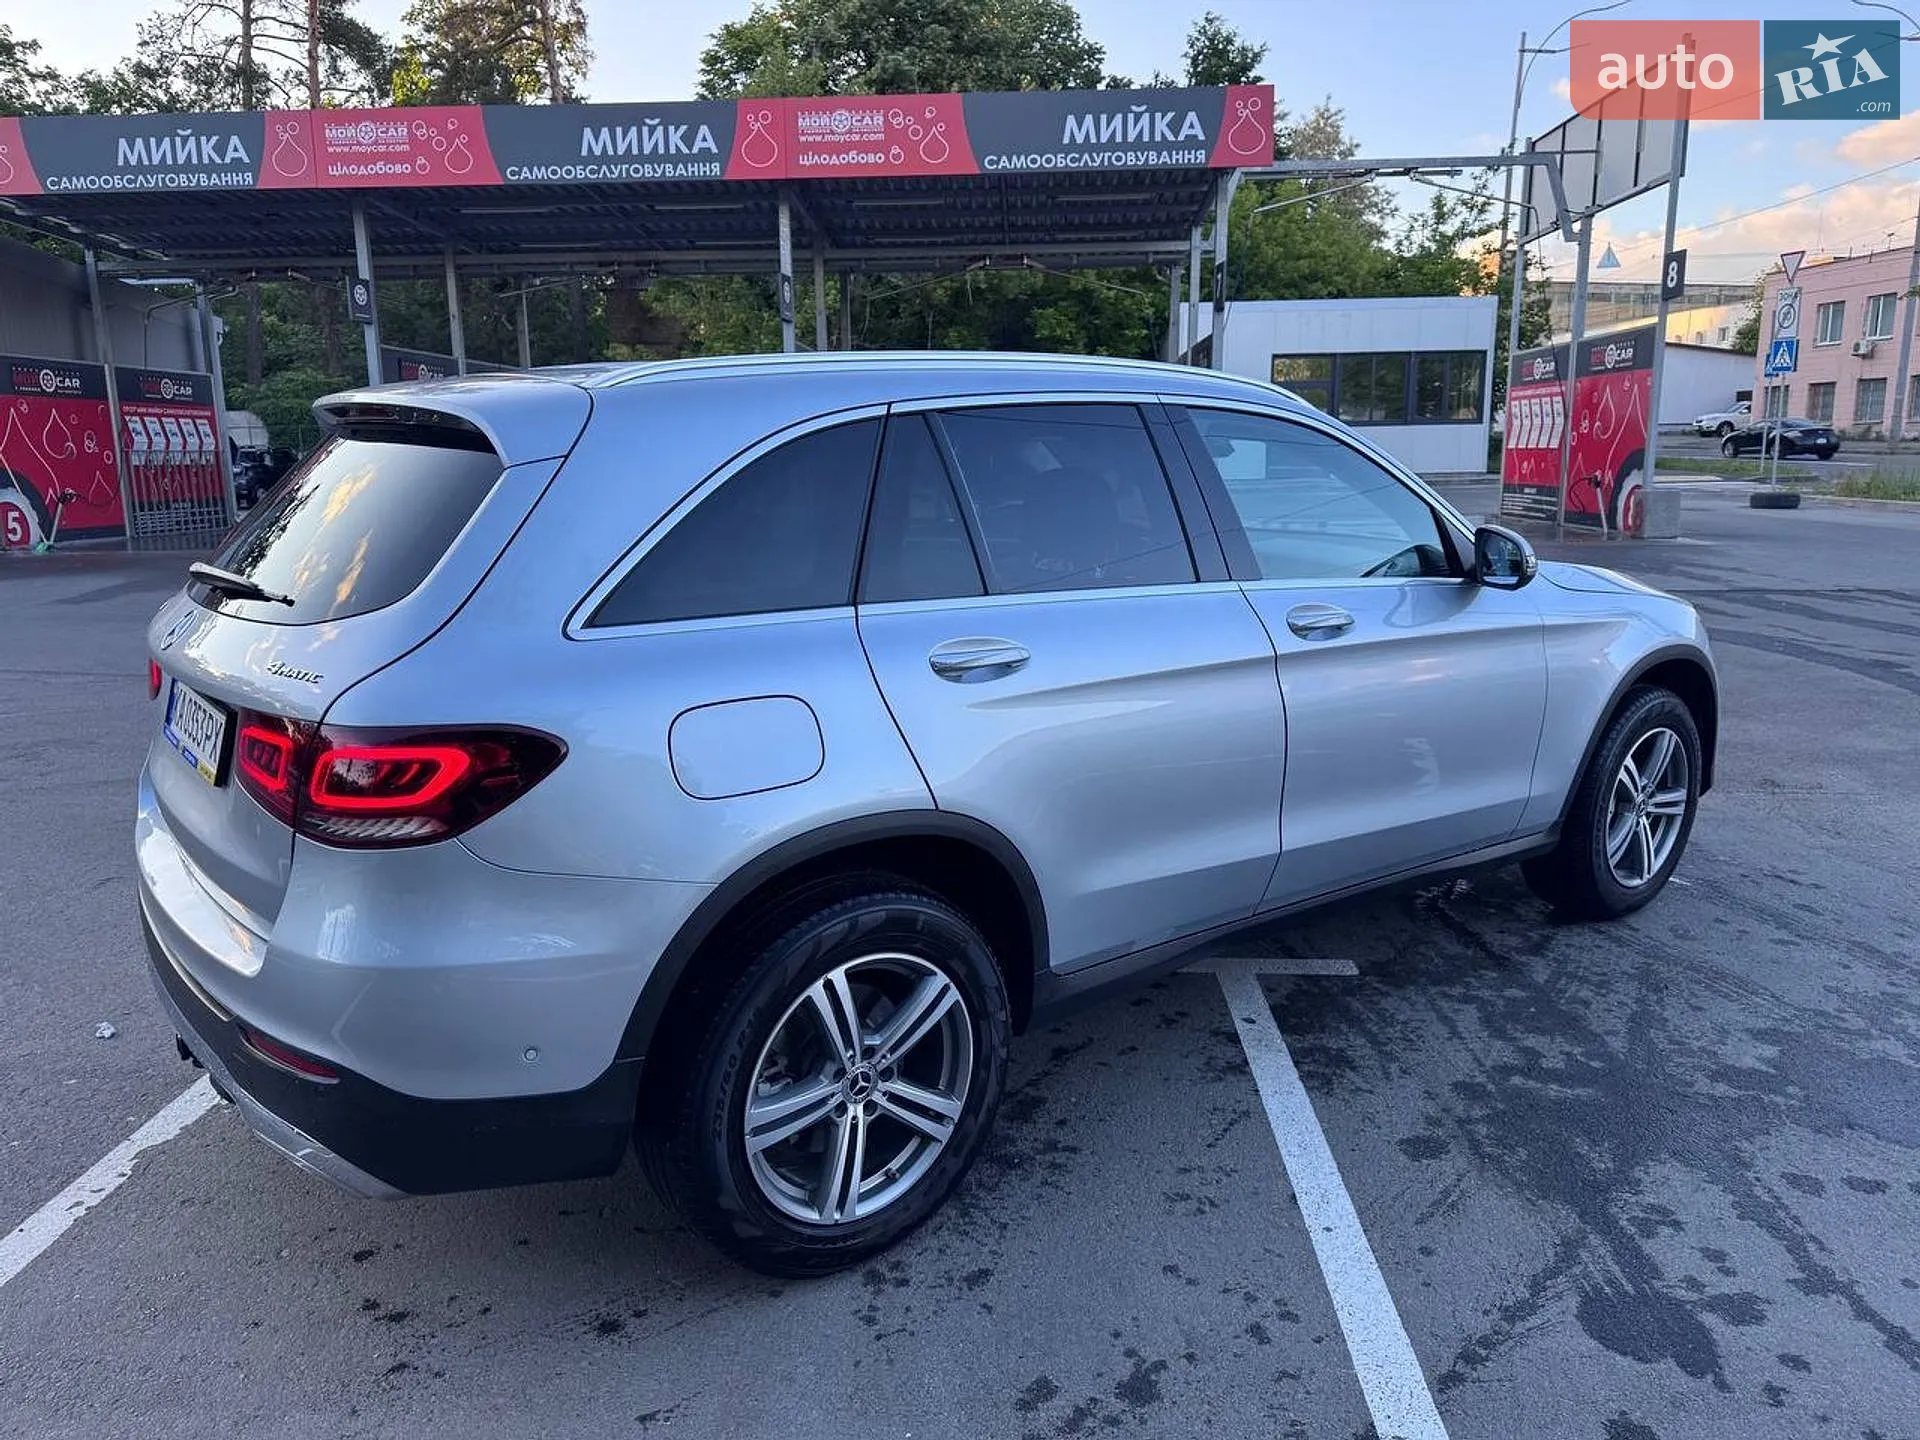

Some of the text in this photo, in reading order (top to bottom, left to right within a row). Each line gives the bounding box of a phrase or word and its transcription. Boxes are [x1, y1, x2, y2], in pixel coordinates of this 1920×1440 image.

[1062, 106, 1207, 145] МИЙКА
[117, 128, 251, 167] МИЙКА
[580, 117, 719, 157] МИЙКА
[798, 131, 885, 143] www.moycar.com
[326, 144, 411, 154] www.moycar.com
[984, 149, 1207, 171] САМООБСЛУГОВУВАННЯ
[46, 172, 254, 191] САМООБСЛУГОВУВАННЯ
[505, 162, 721, 182] САМООБСЛУГОВУВАННЯ
[1666, 260, 1678, 288] 8
[56, 376, 81, 389] CAR
[173, 385, 193, 396] CAR
[7, 511, 22, 542] 5
